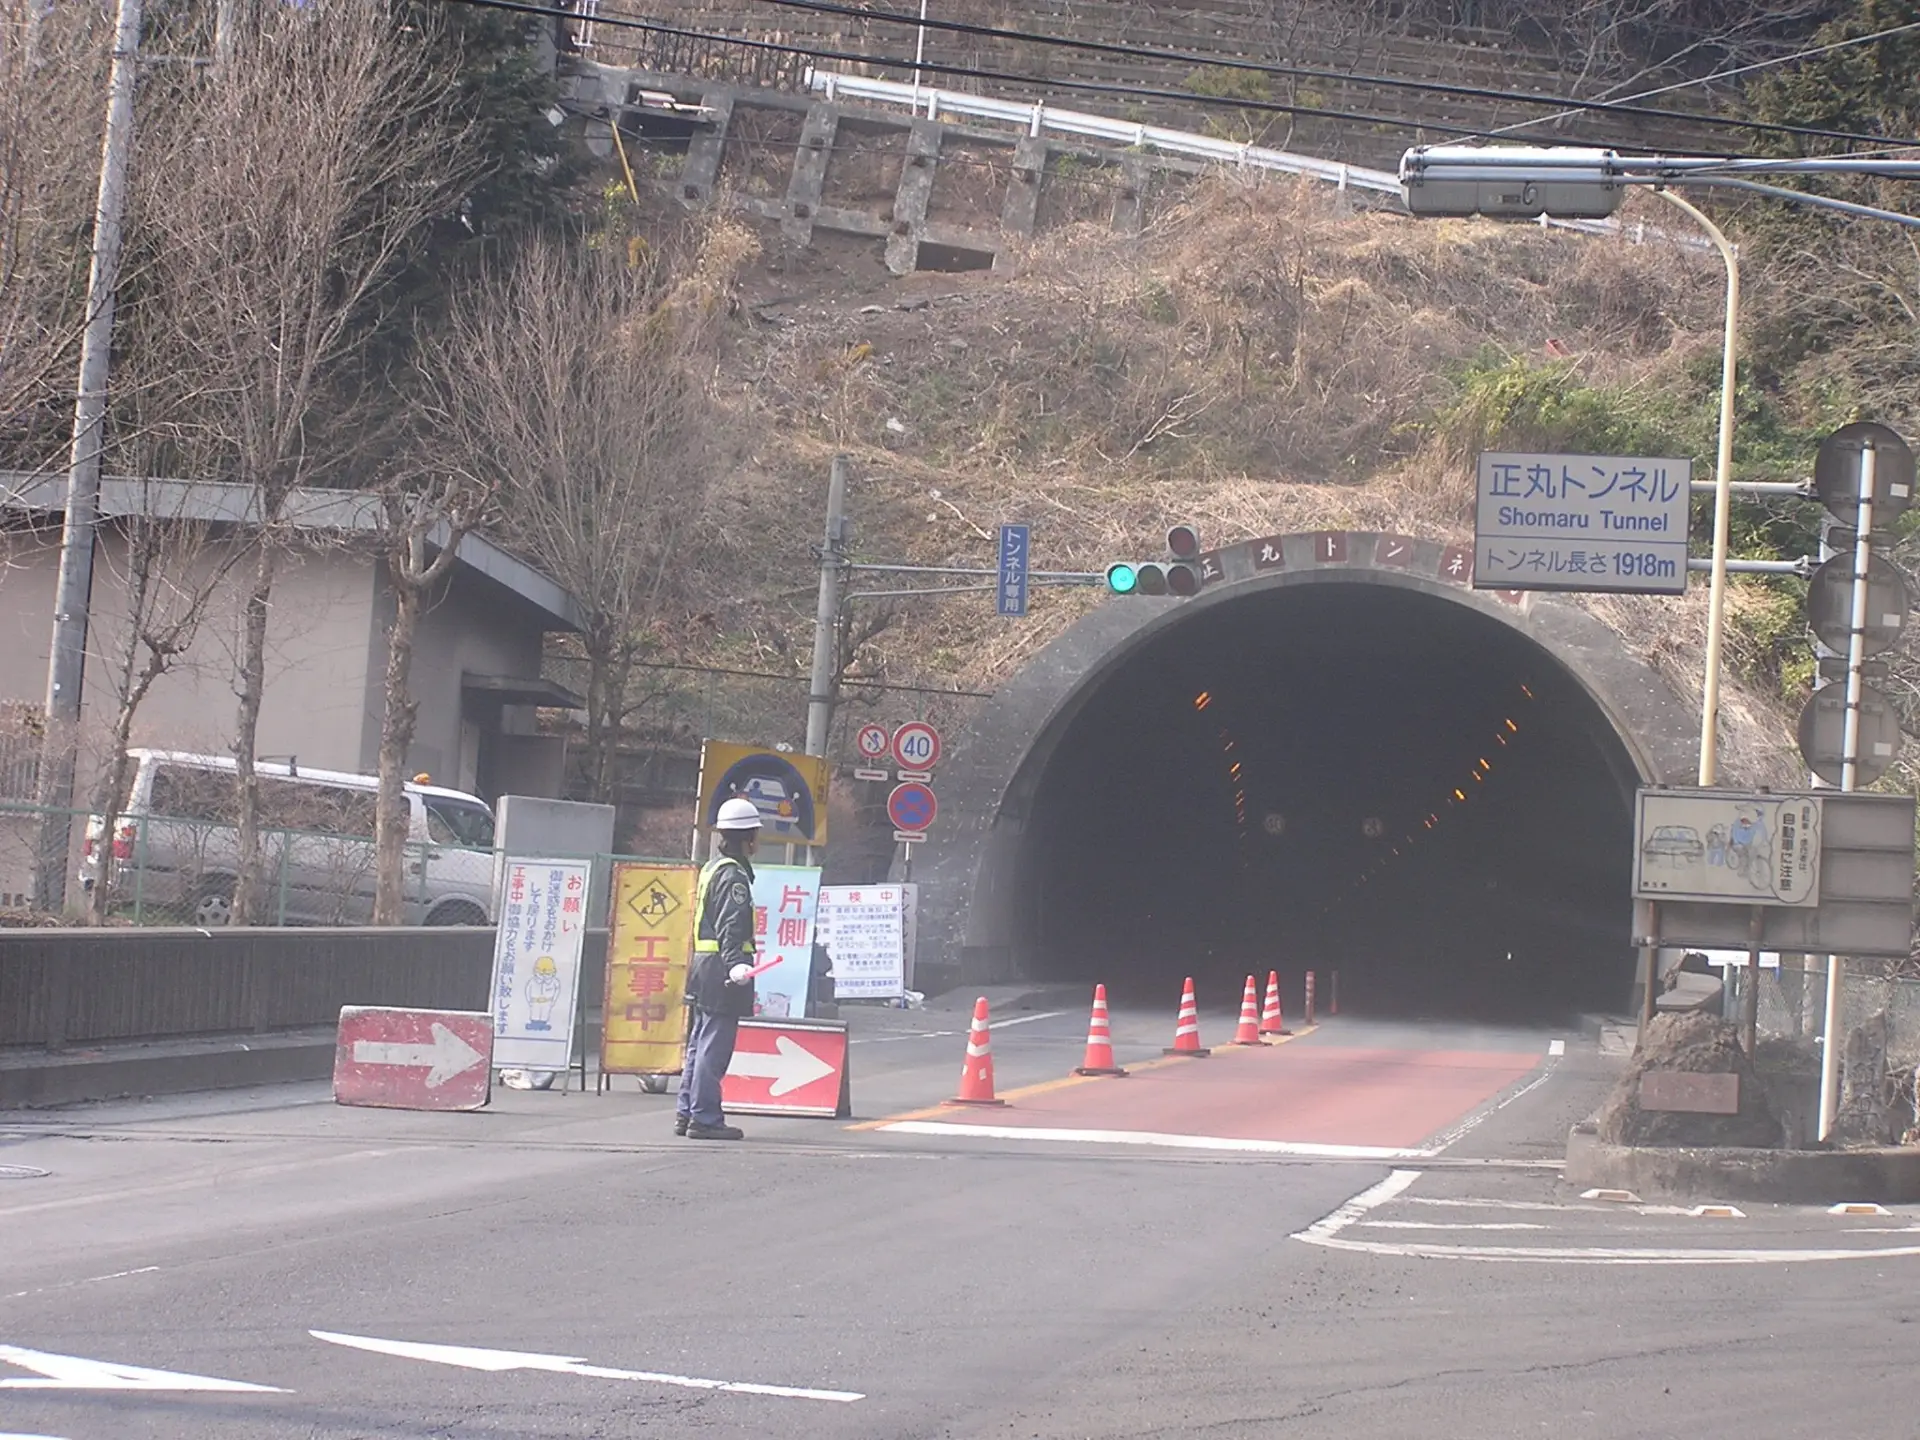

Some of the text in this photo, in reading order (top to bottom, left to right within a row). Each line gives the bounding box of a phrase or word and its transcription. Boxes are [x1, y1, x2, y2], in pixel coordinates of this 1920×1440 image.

[1489, 463, 1680, 502] 正丸トンネル
[1498, 506, 1668, 532] Shomaru Tunnel
[1003, 527, 1022, 613] トンネル専用
[903, 735, 930, 757] 40
[562, 875, 583, 933] お願い
[776, 884, 811, 947] 片側
[625, 935, 670, 1031] 工事中
